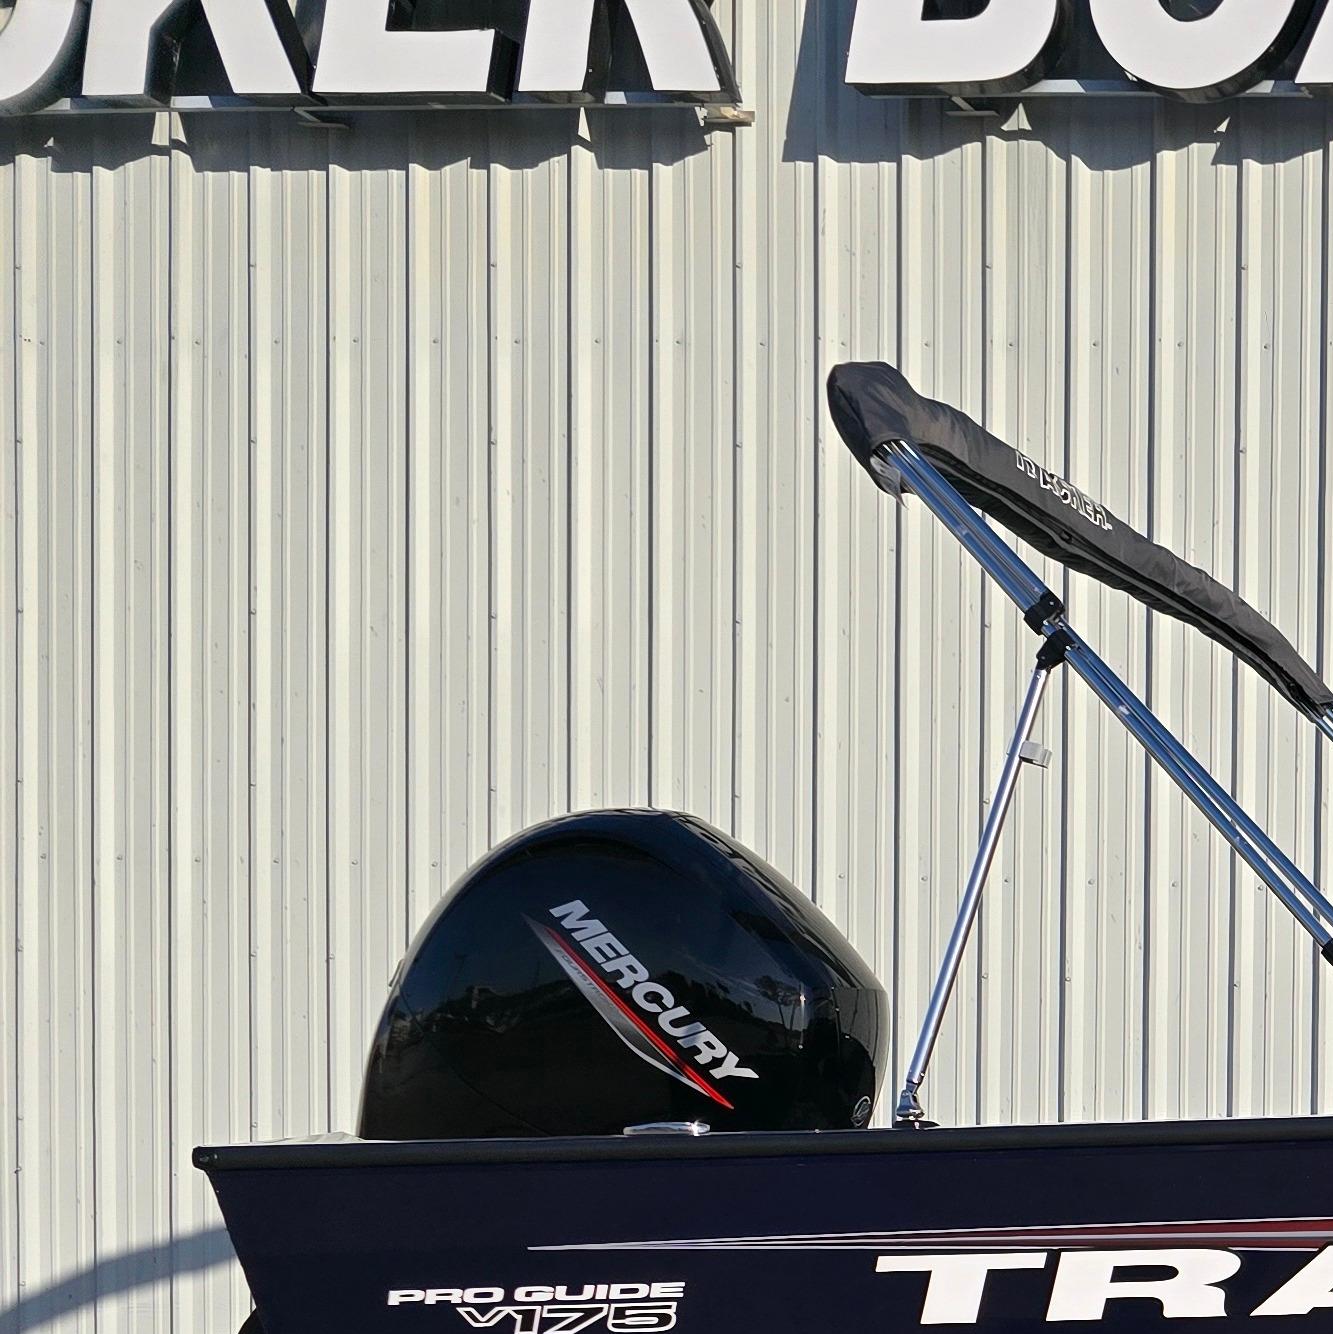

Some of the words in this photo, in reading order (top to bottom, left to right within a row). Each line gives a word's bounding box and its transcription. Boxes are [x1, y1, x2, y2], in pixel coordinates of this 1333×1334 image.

[549, 899, 759, 1079] MERCURY
[387, 1286, 504, 1306] PRO
[513, 1281, 686, 1303] GUIDE
